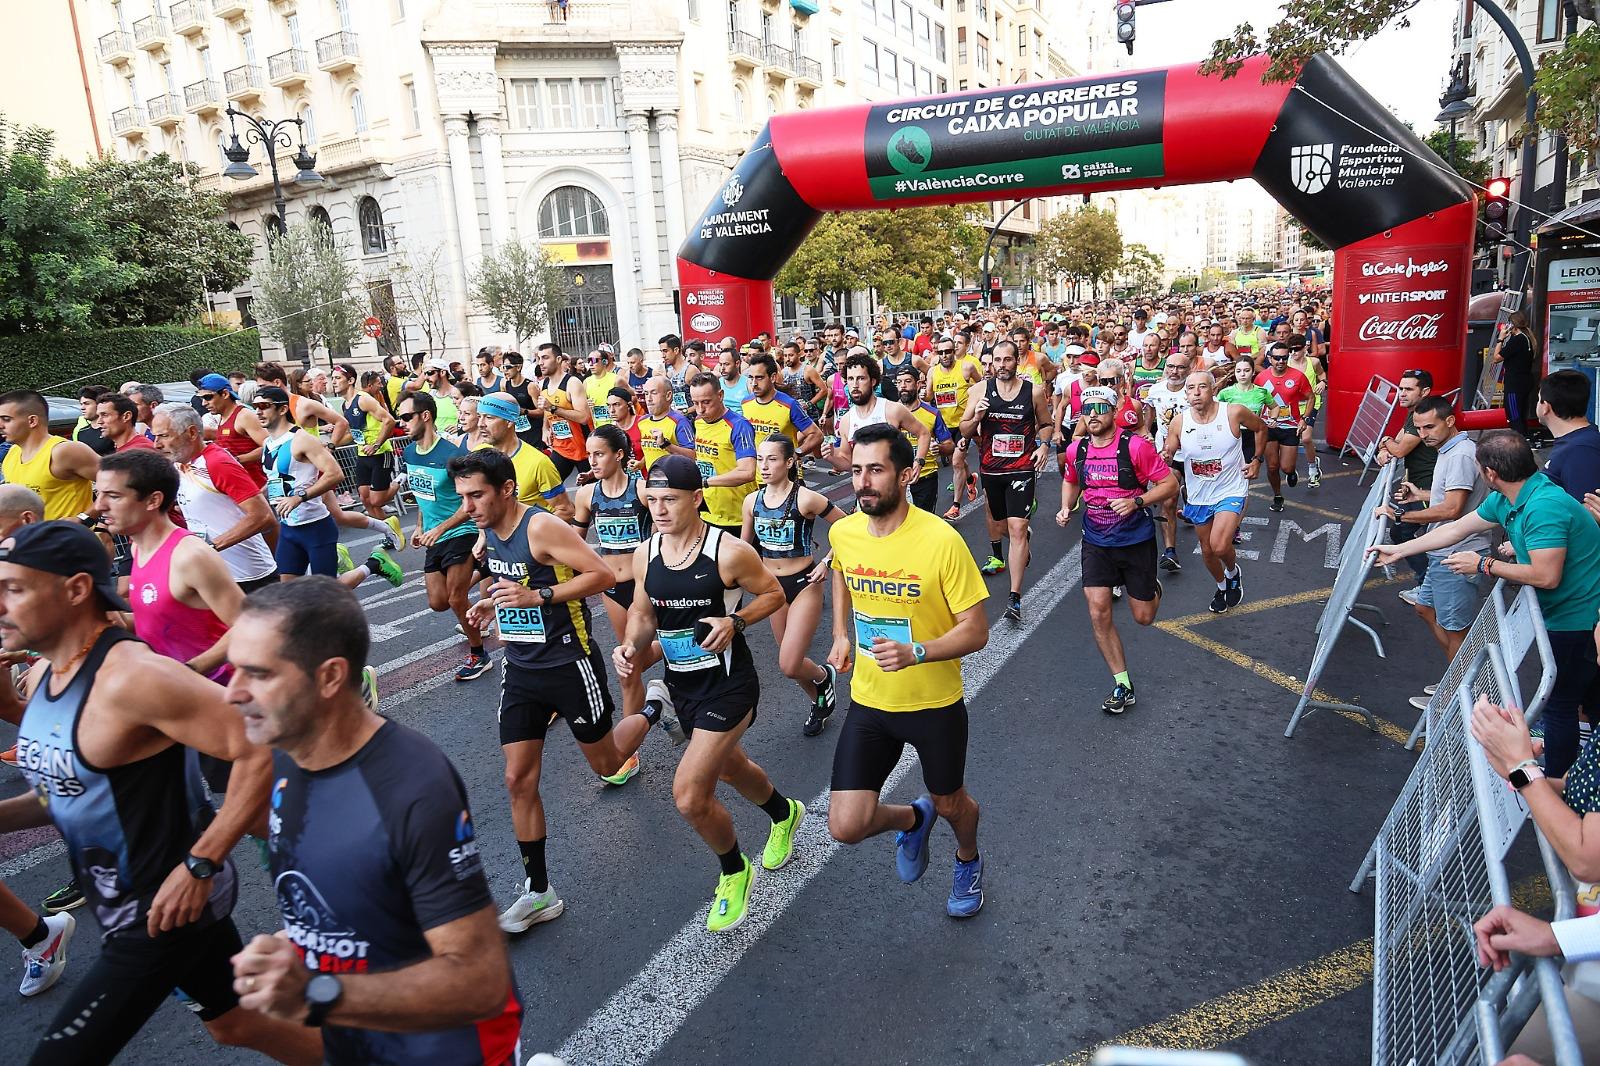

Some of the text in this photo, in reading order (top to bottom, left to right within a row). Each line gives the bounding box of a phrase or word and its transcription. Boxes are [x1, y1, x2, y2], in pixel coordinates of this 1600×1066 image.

[887, 79, 1138, 123] CIRCUIT DE CARRERES
[1024, 118, 1140, 142] CIUTAT DE VALÈNCIA
[1082, 161, 1114, 171] caixa
[1338, 155, 1402, 167] Esportiva
[1083, 164, 1133, 178] popular
[1338, 164, 1404, 179] Municipal
[894, 171, 1025, 193] #ValènciaCorre
[1337, 177, 1395, 190] València
[702, 208, 770, 227] AJUNTAMENT
[700, 222, 773, 239] DE VALÈNCIA
[1370, 289, 1448, 304] INTERSPORT
[1358, 312, 1445, 341] Coca-Cola
[408, 475, 433, 491] 2332
[598, 523, 637, 537] 2078
[846, 575, 921, 598] runners
[498, 608, 541, 625] 2296
